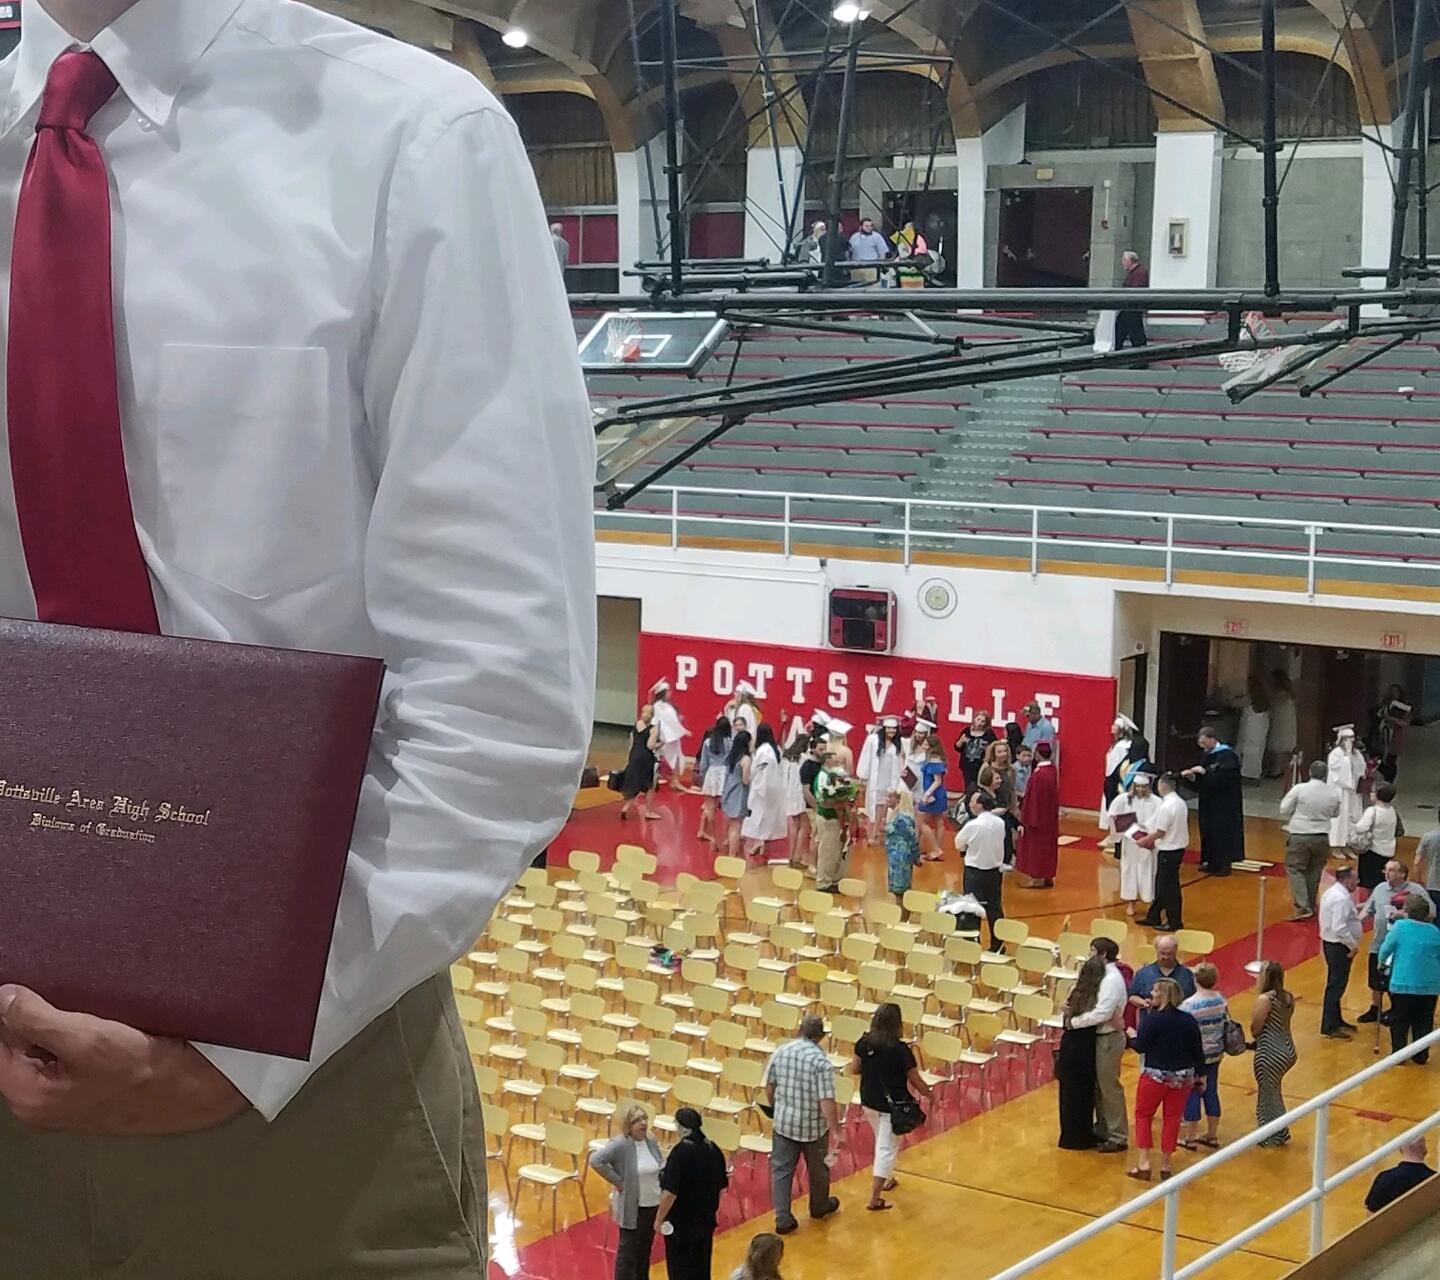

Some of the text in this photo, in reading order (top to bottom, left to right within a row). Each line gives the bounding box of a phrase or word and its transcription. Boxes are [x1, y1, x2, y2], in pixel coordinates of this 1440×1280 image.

[675, 654, 1061, 734] POTTSVILLE
[65, 790, 105, 811] Area
[109, 795, 150, 822] High
[154, 802, 211, 827] School
[79, 821, 93, 834] of
